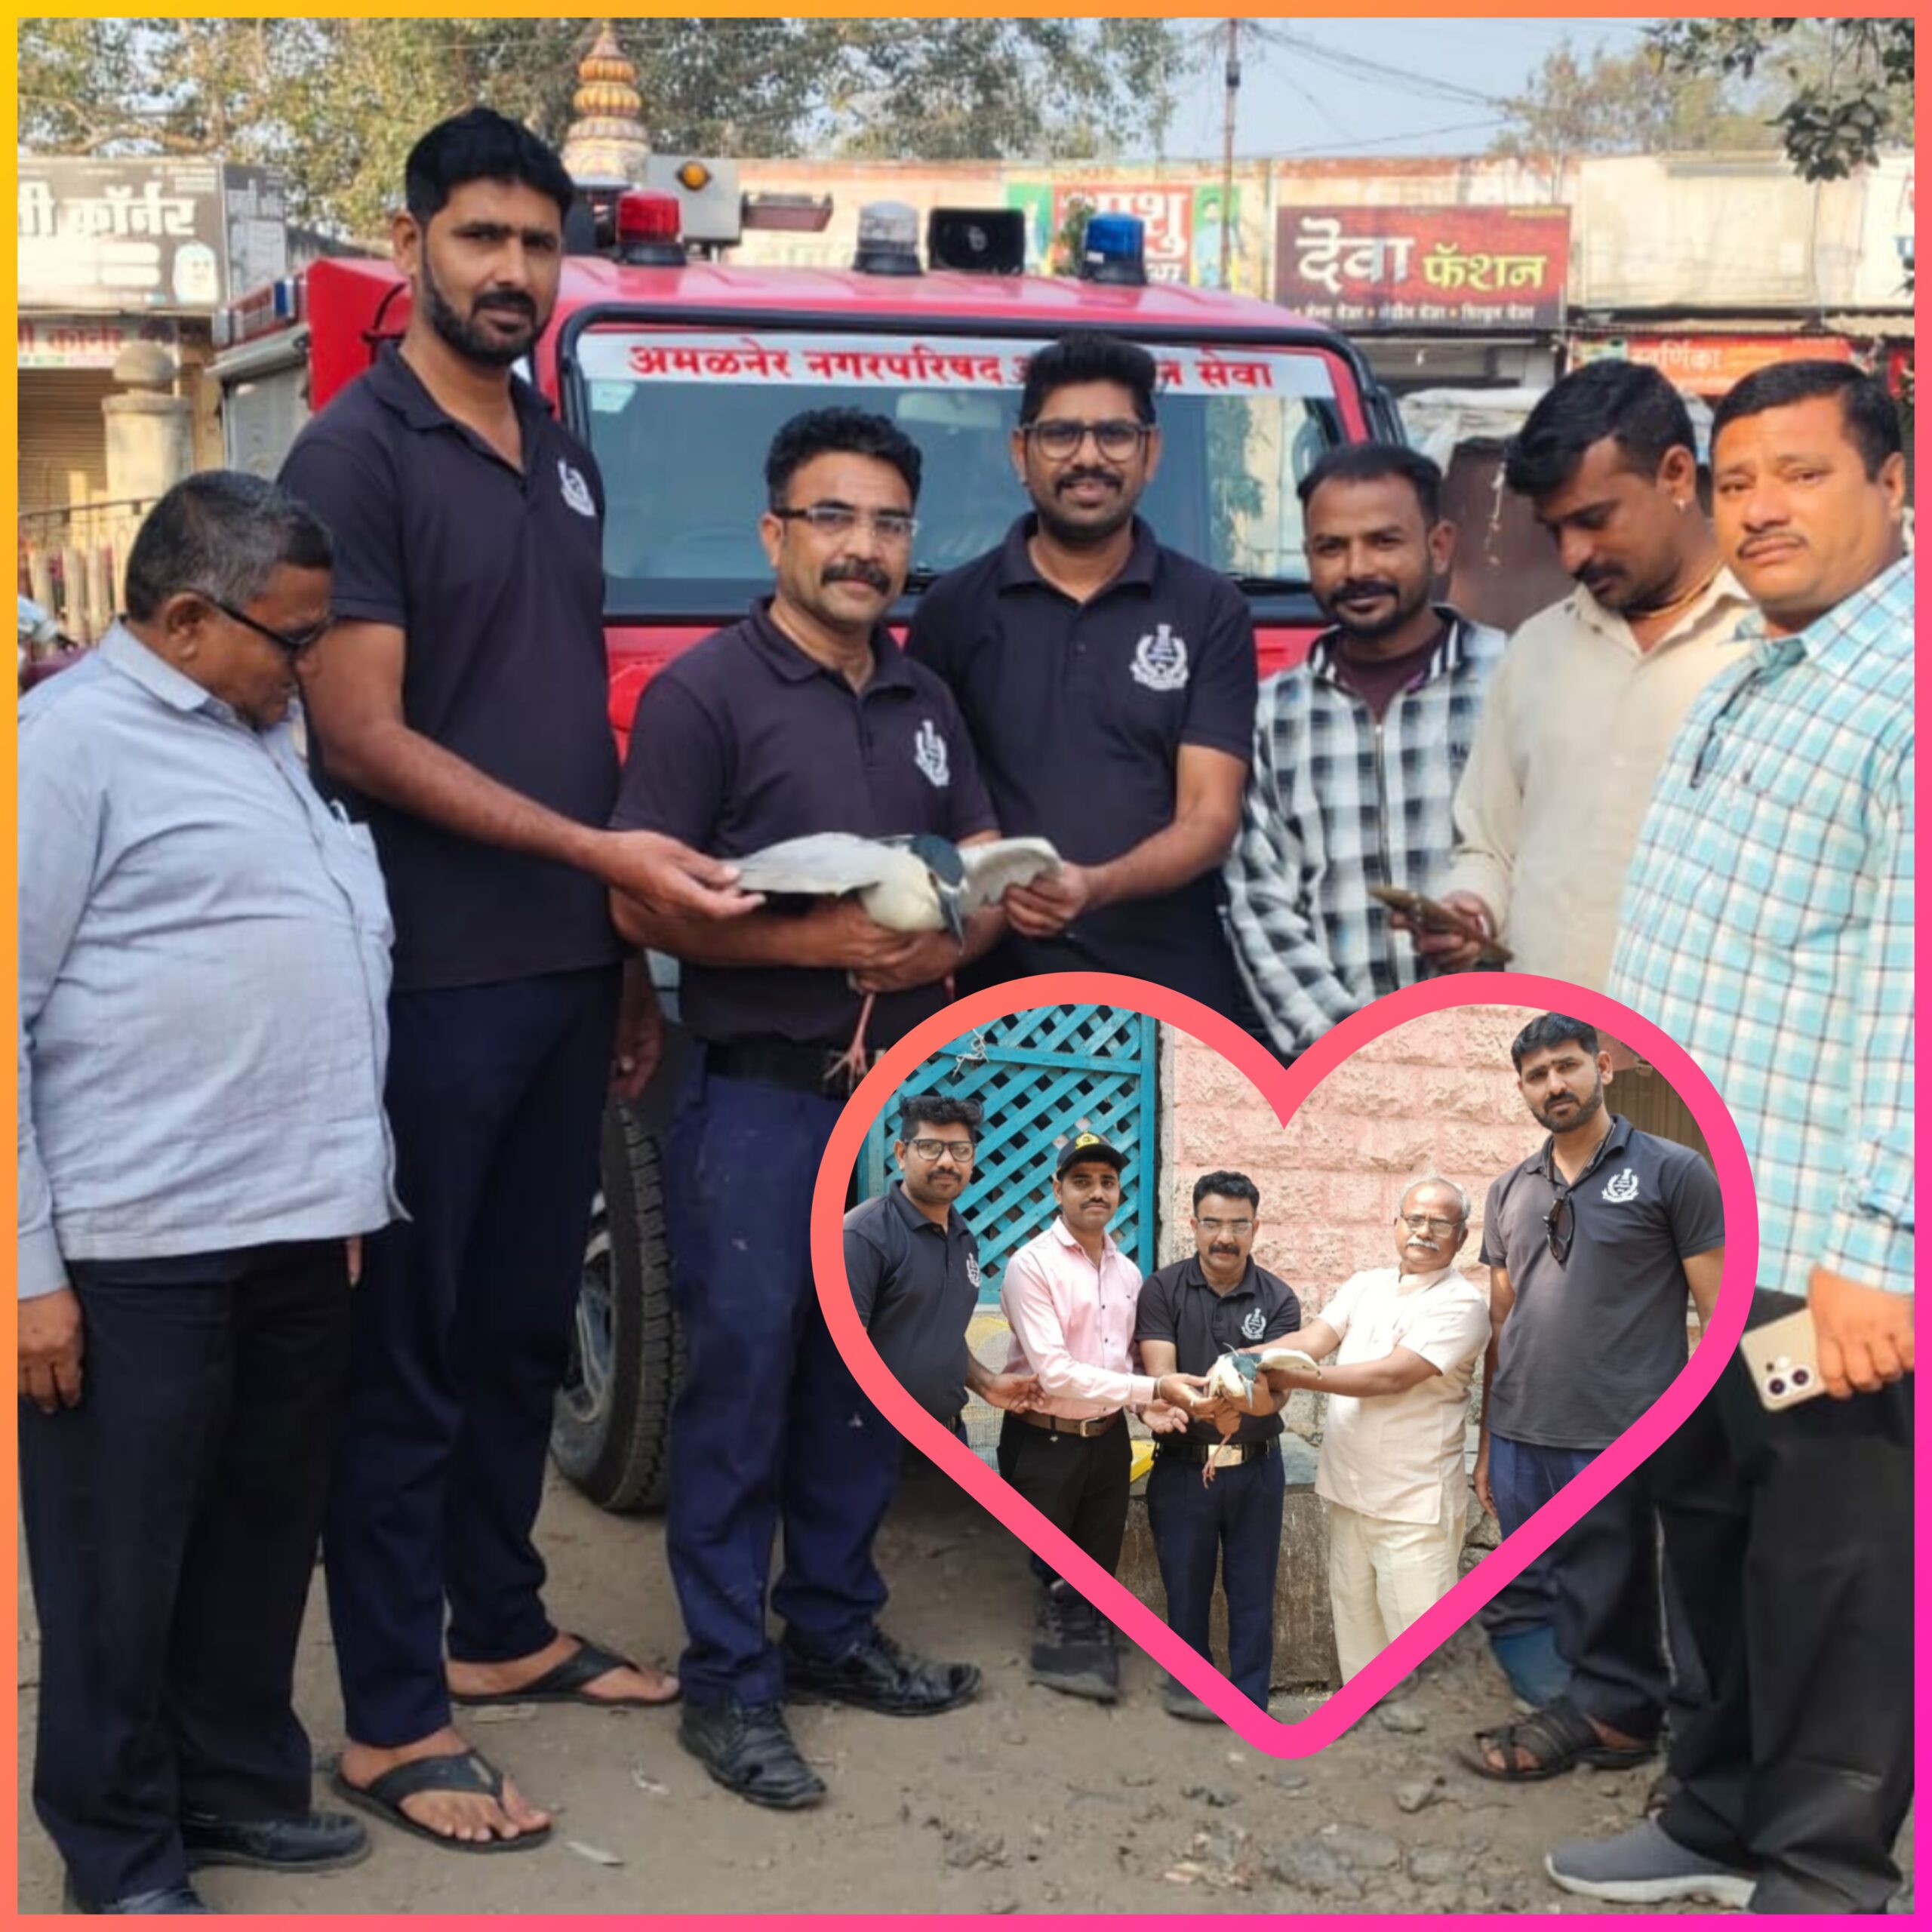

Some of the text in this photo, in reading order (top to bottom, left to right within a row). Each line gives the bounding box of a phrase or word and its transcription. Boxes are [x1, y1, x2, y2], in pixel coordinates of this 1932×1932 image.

[59, 182, 196, 236] कॉर्नर
[1295, 216, 1547, 293] देवा फॅशन
[629, 336, 792, 378] अमळनेर
[801, 343, 1004, 386] नगरपरिषद
[1195, 344, 1273, 388] सेवा
